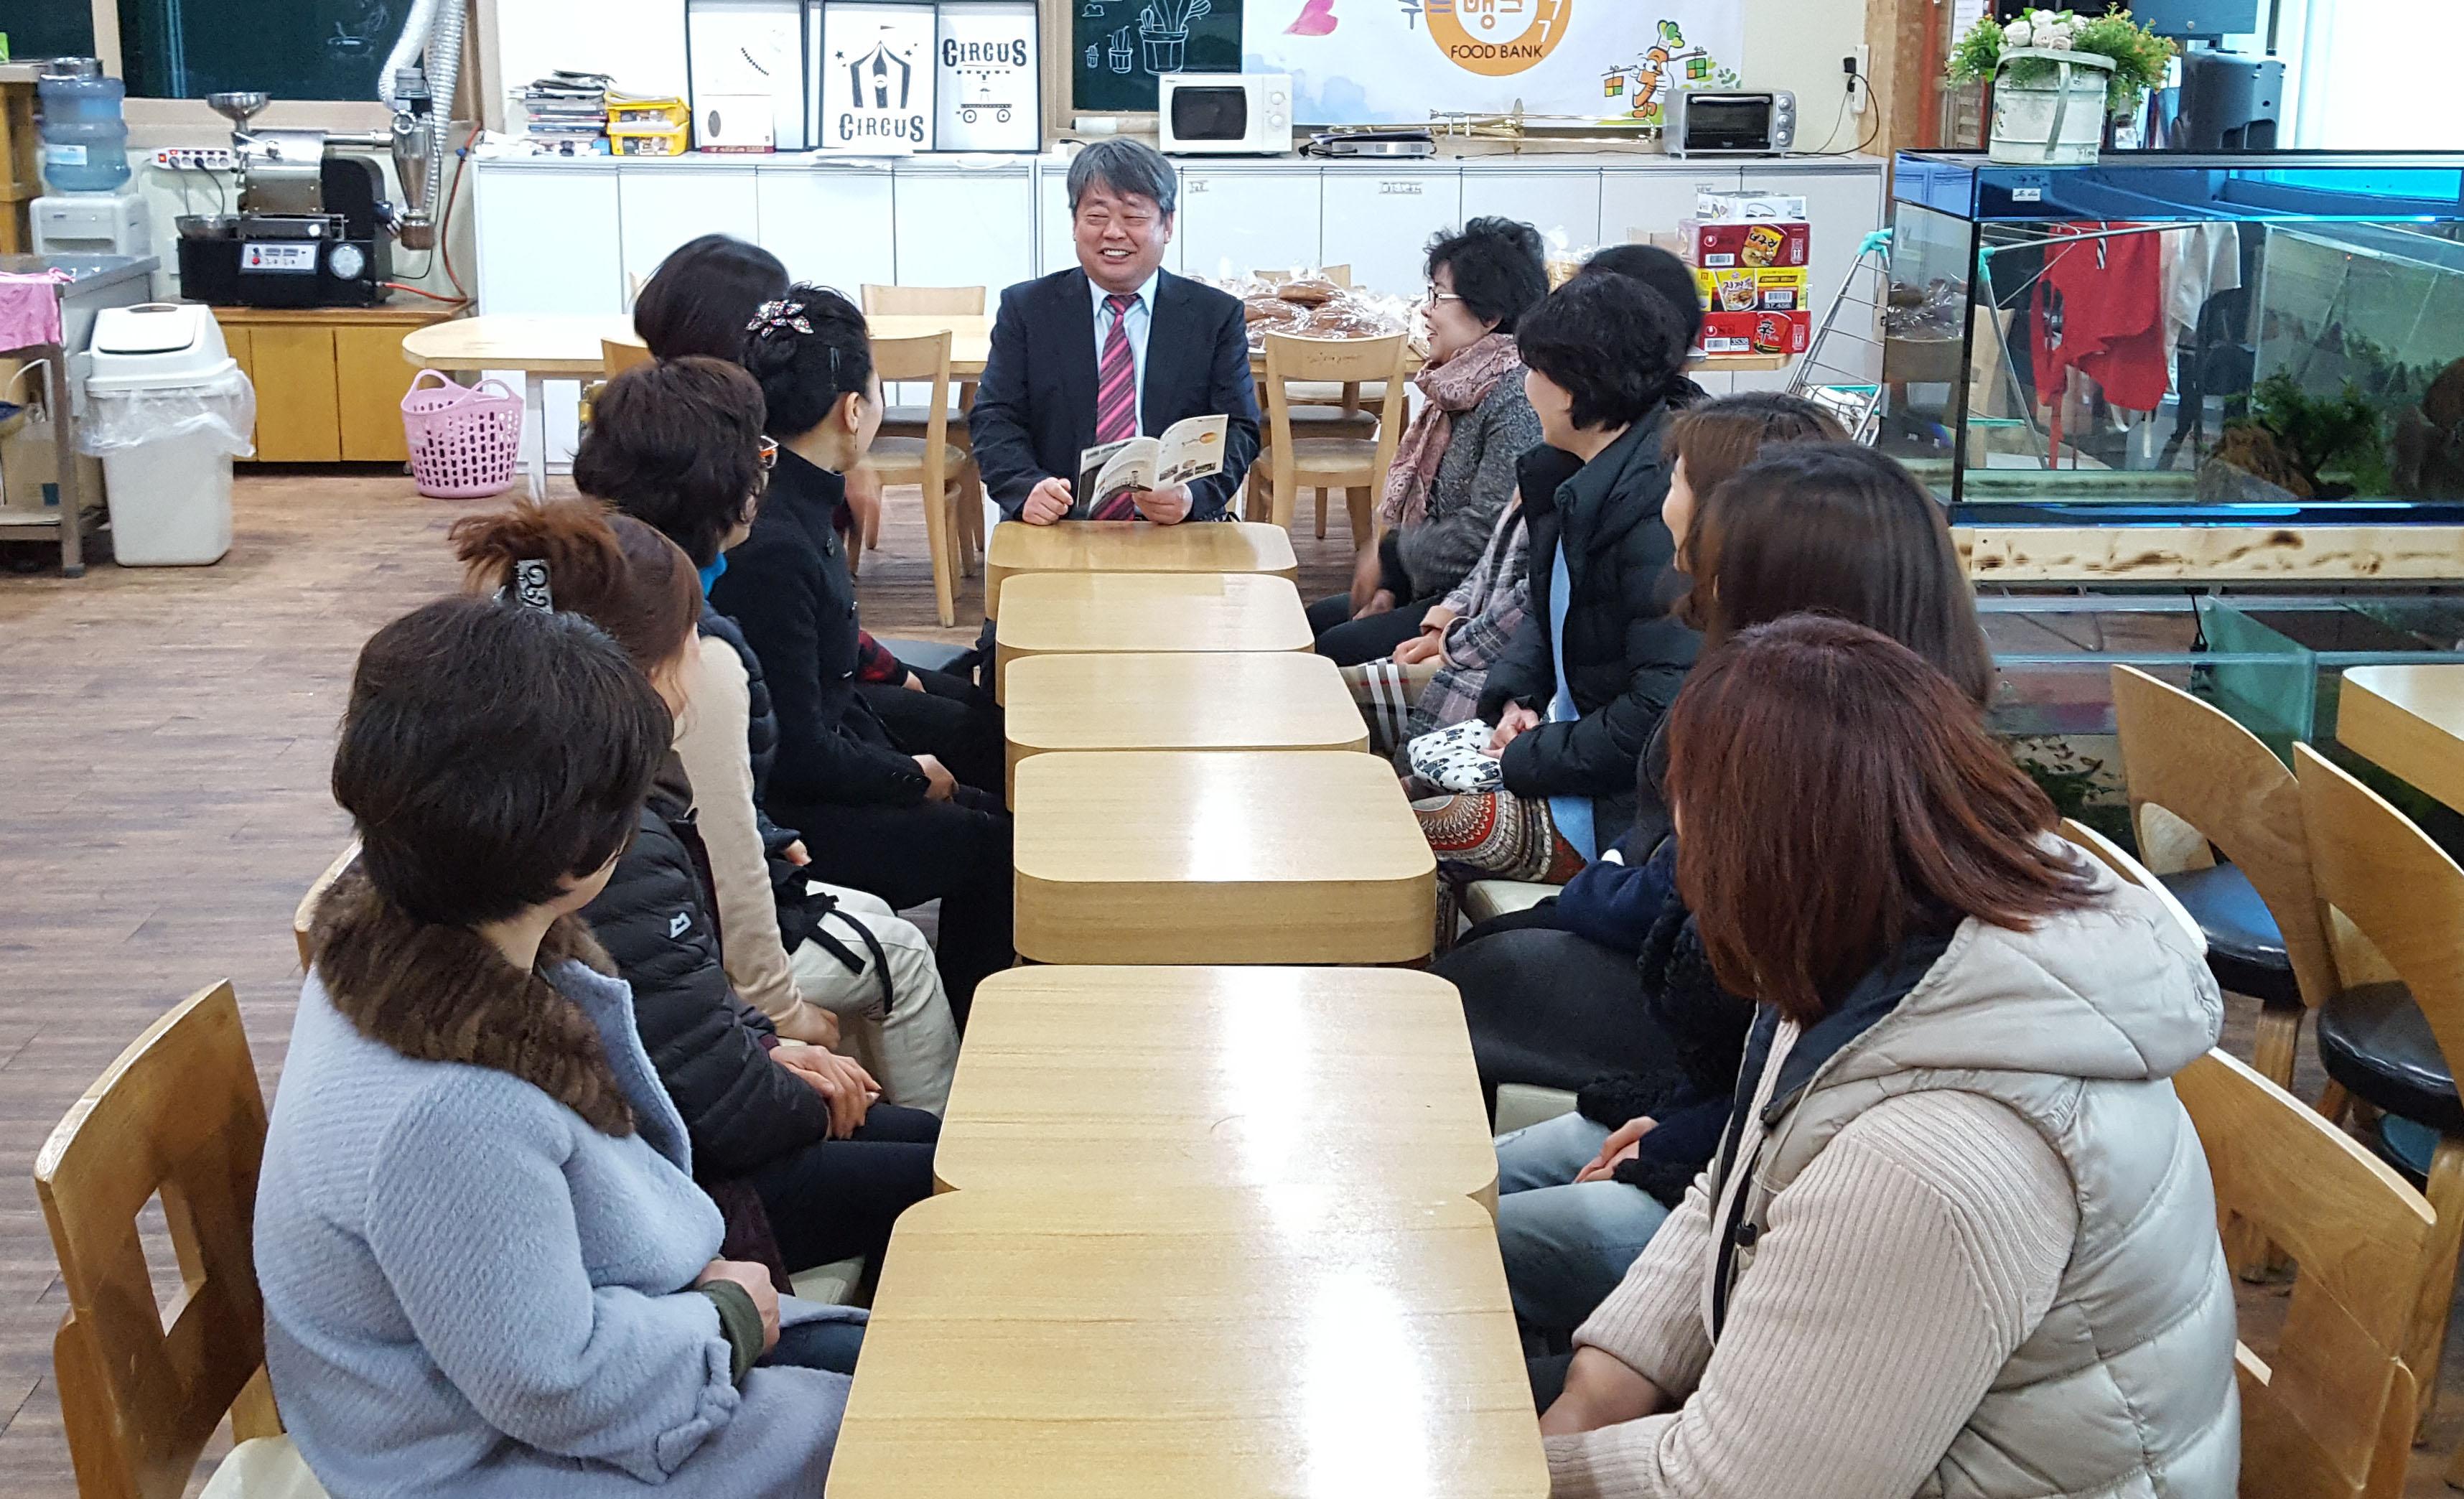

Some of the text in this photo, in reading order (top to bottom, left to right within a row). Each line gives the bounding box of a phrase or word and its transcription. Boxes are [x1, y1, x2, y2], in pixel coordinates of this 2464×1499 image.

[942, 38, 1027, 67] CIRCUS
[1450, 45, 1543, 58] FOOD BANK
[839, 113, 924, 142] CIRCUS
